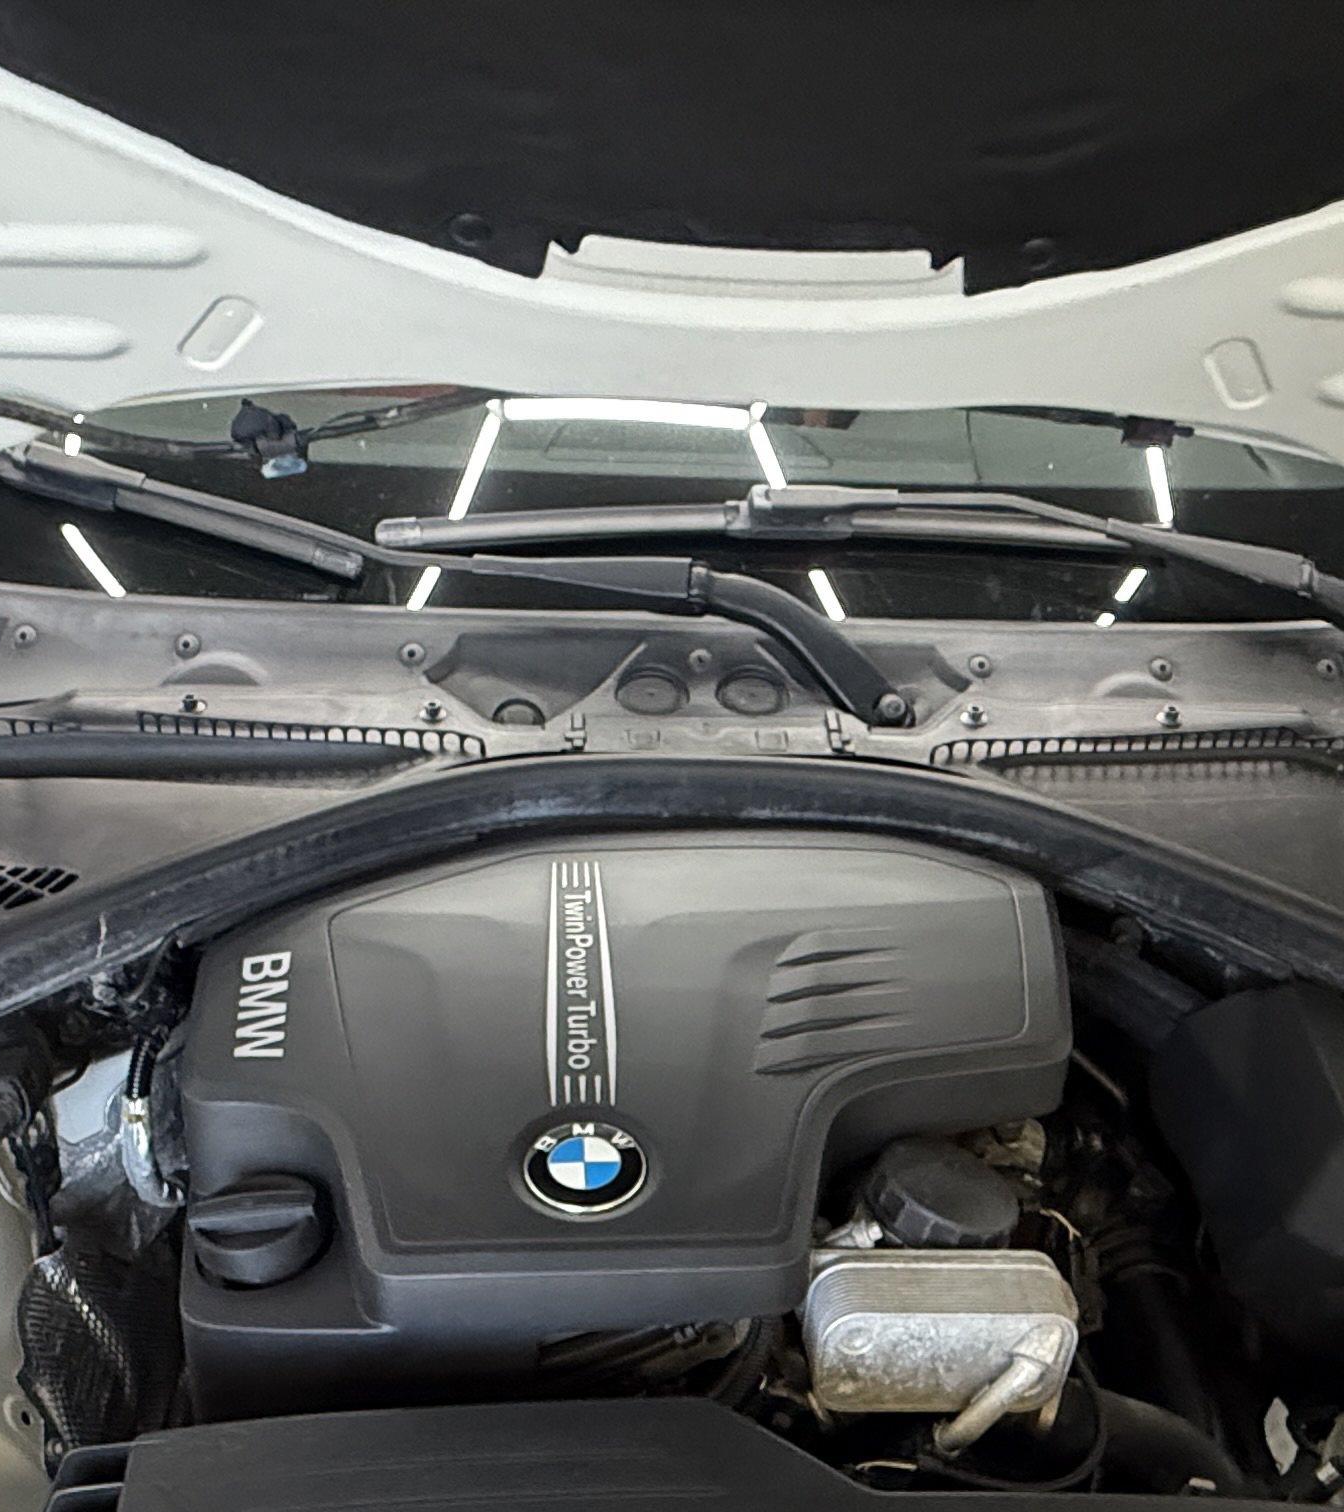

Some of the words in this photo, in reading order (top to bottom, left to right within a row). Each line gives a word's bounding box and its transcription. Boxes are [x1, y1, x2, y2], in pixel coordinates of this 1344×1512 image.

[563, 889, 594, 999] TwinPower
[233, 950, 292, 1058] BMW
[567, 1000, 598, 1070] Turbo
[534, 1122, 638, 1153] BMW
